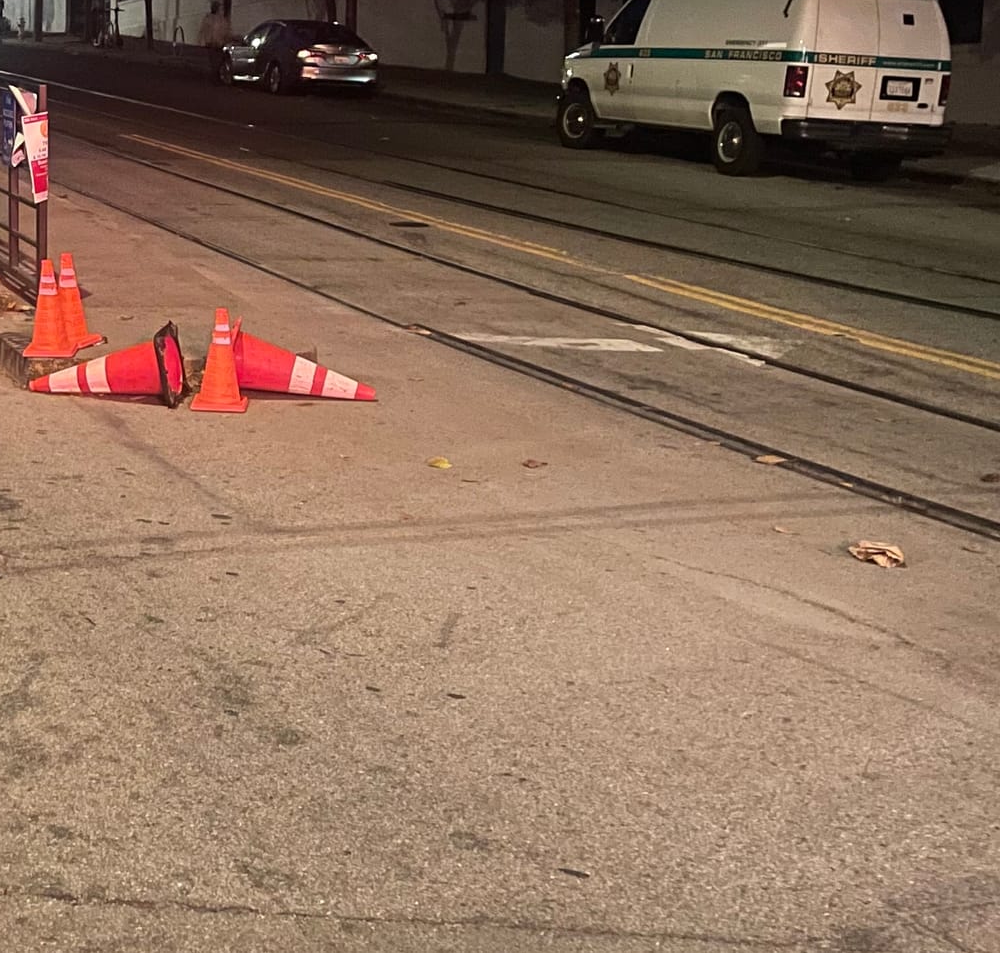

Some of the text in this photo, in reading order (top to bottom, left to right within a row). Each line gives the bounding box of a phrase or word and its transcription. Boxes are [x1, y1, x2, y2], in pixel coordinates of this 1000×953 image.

[704, 49, 782, 61] SAN FRANCISCO
[819, 53, 877, 66] SHERIFF
